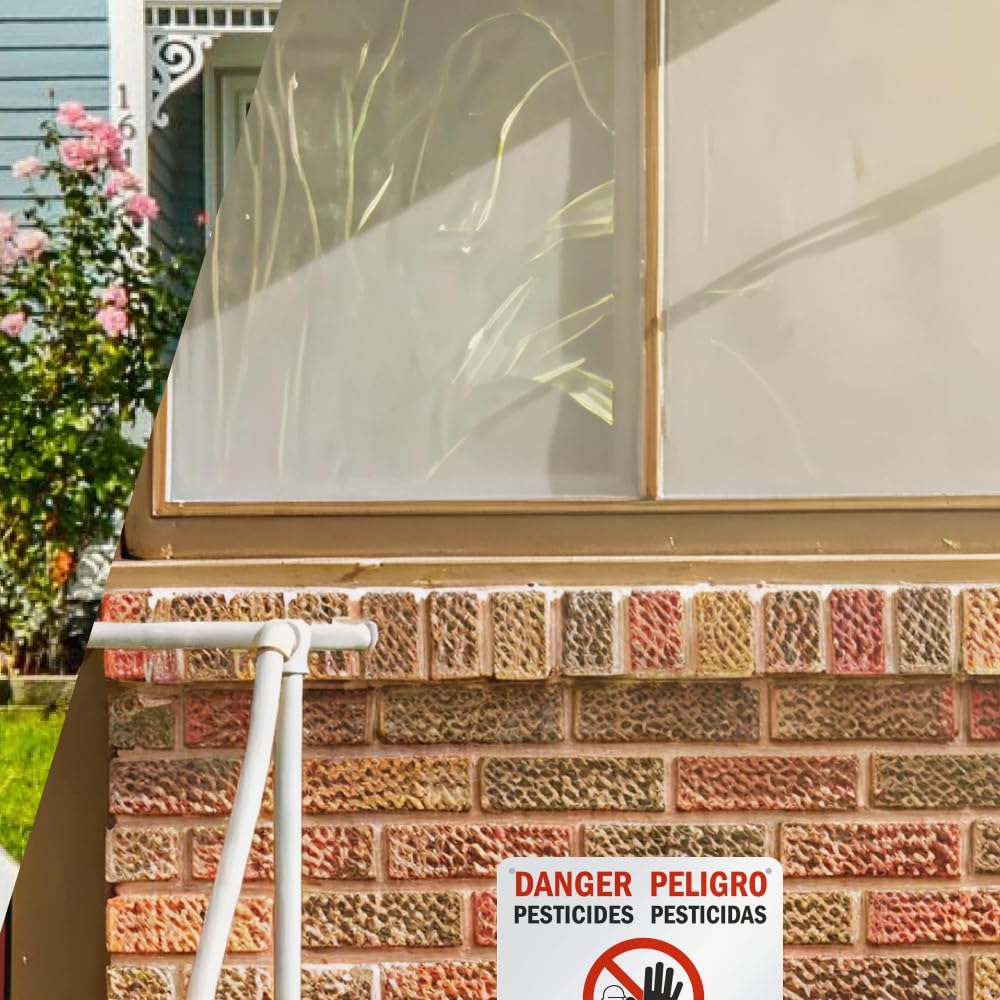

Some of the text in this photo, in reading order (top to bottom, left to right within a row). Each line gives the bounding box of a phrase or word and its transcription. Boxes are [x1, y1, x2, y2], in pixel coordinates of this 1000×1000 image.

[515, 870, 768, 898] DANGER PELIGRO
[514, 904, 767, 925] PESTICIDES PESTICIDAS
